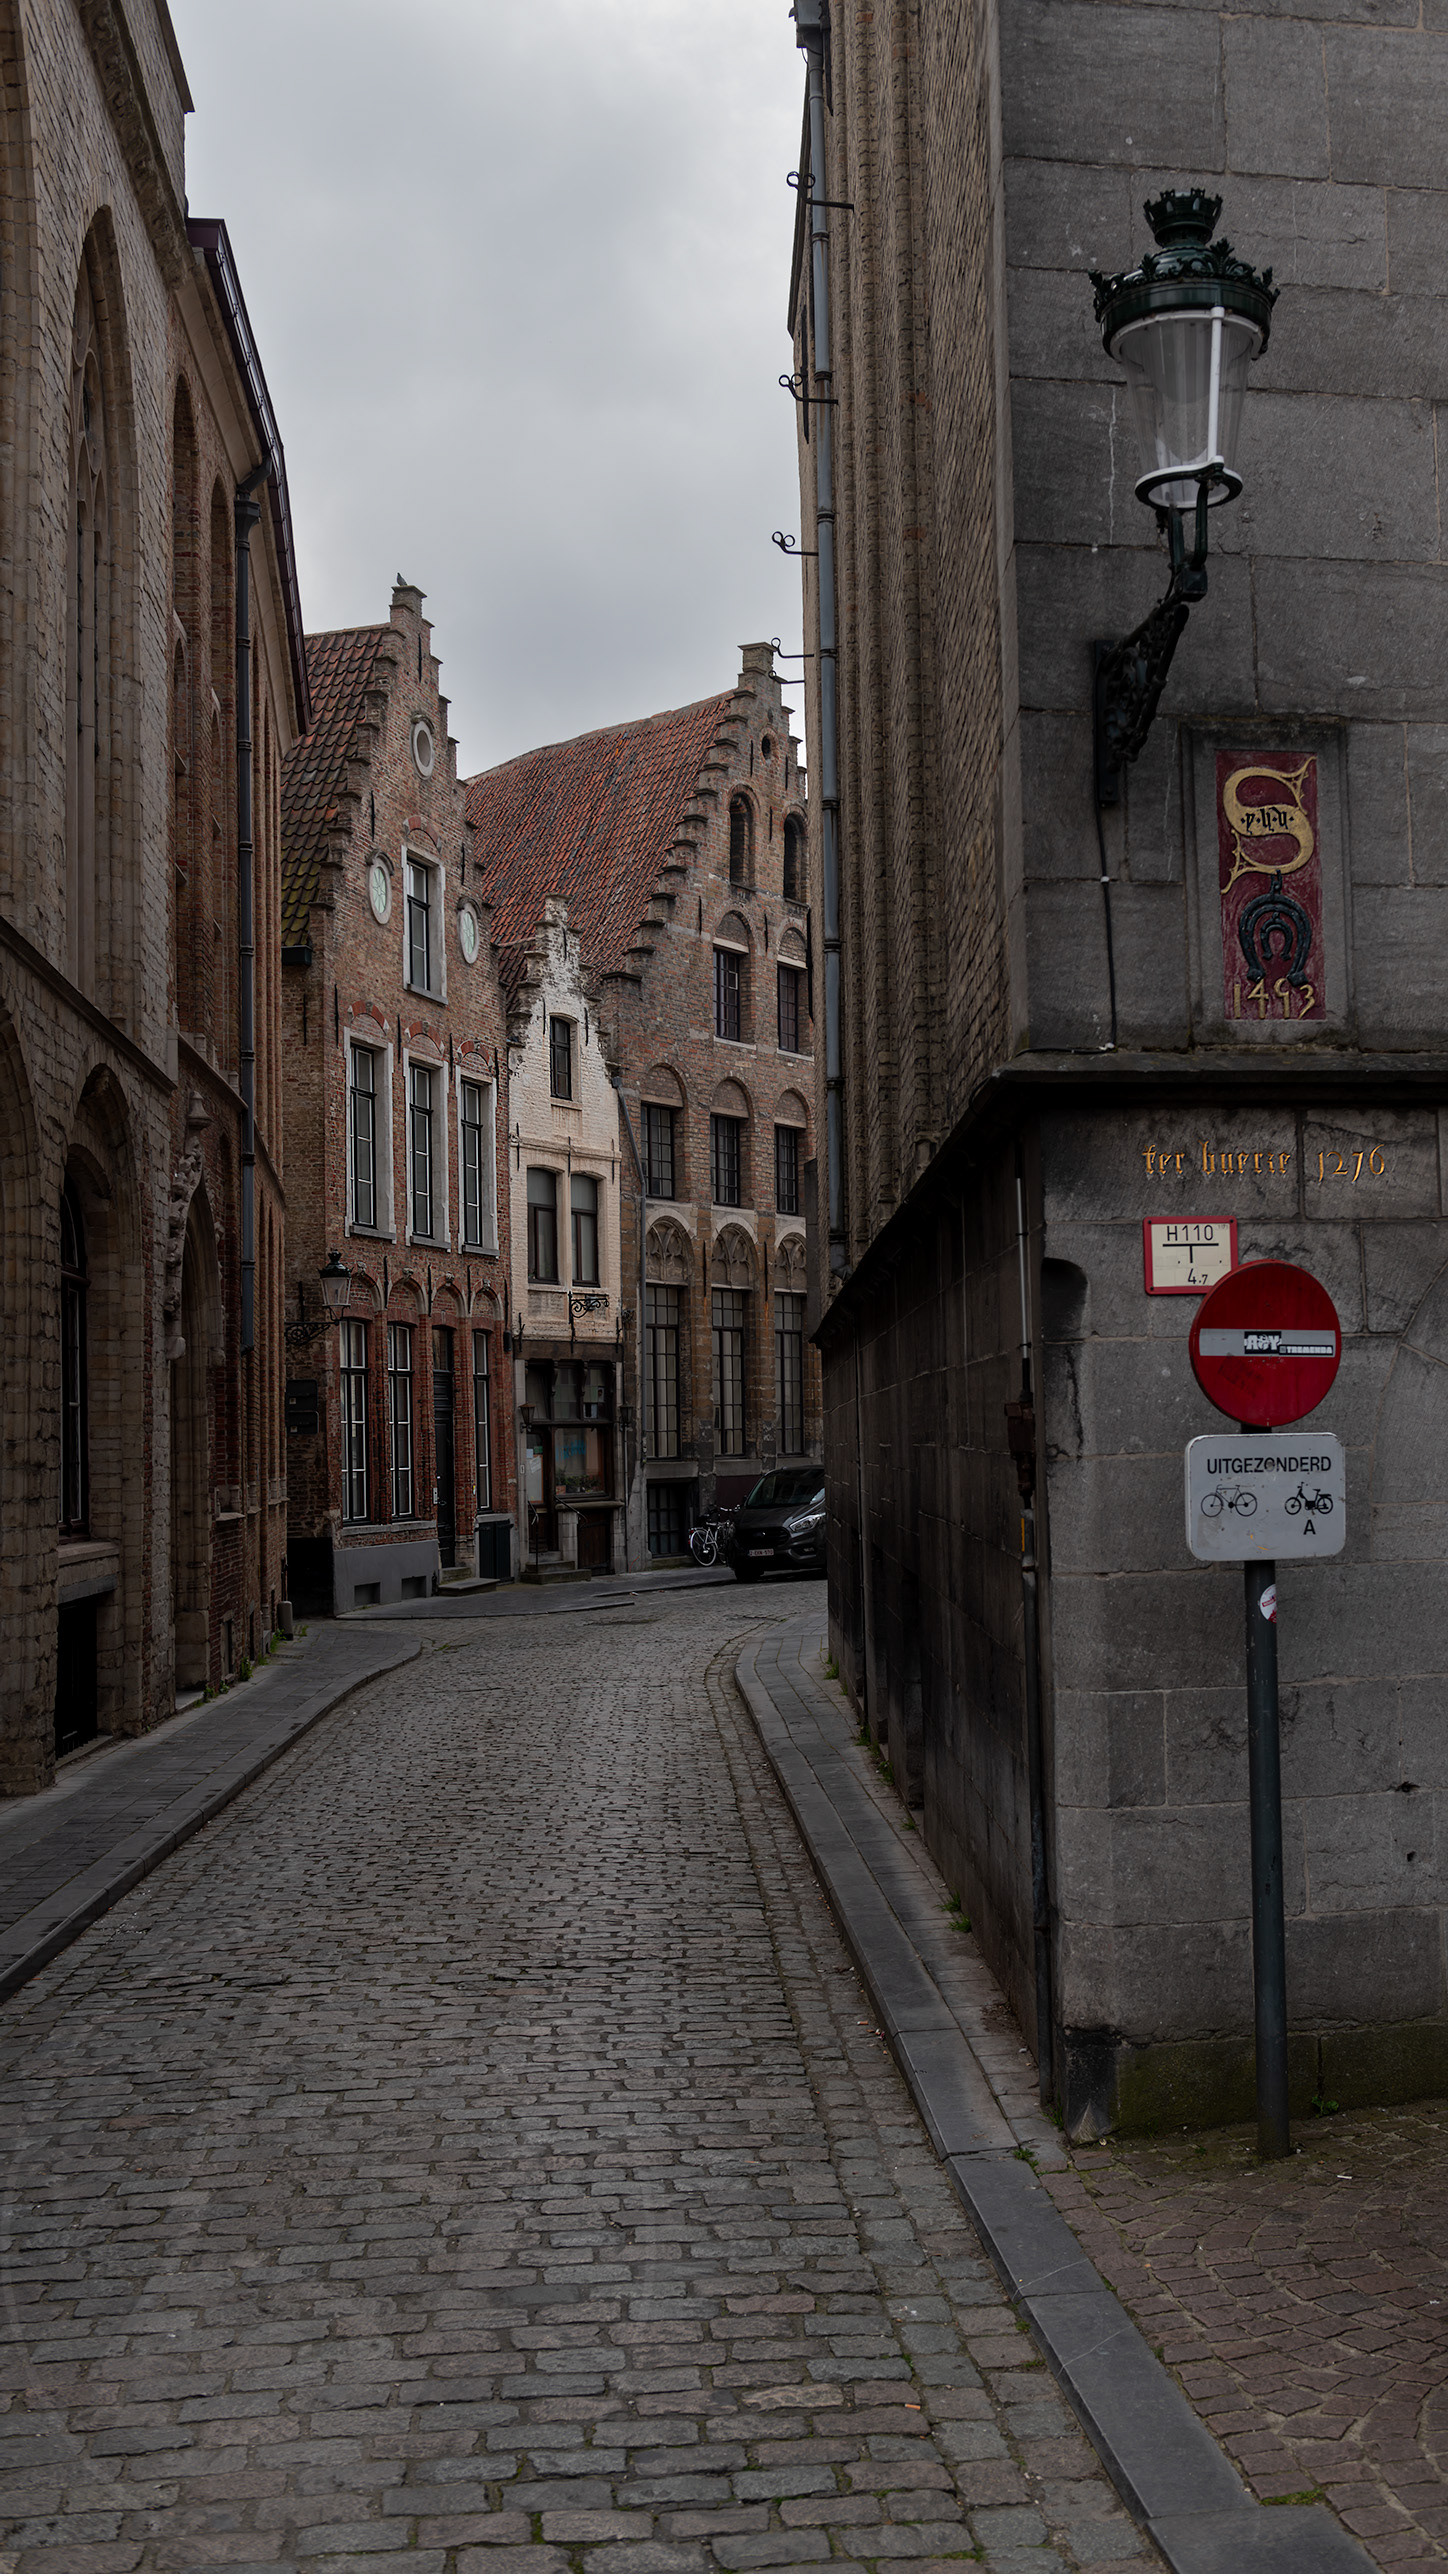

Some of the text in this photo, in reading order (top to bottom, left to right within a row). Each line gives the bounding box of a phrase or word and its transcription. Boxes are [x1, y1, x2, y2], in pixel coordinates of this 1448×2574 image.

[1233, 977, 1316, 1020] 1493
[1141, 1144, 1185, 1175] ter
[1317, 1143, 1385, 1183] 1276
[1166, 1224, 1213, 1241] H110
[1187, 1268, 1208, 1284] 4.7
[1207, 1456, 1332, 1474] UITGEZONDERD
[1303, 1519, 1316, 1535] A
